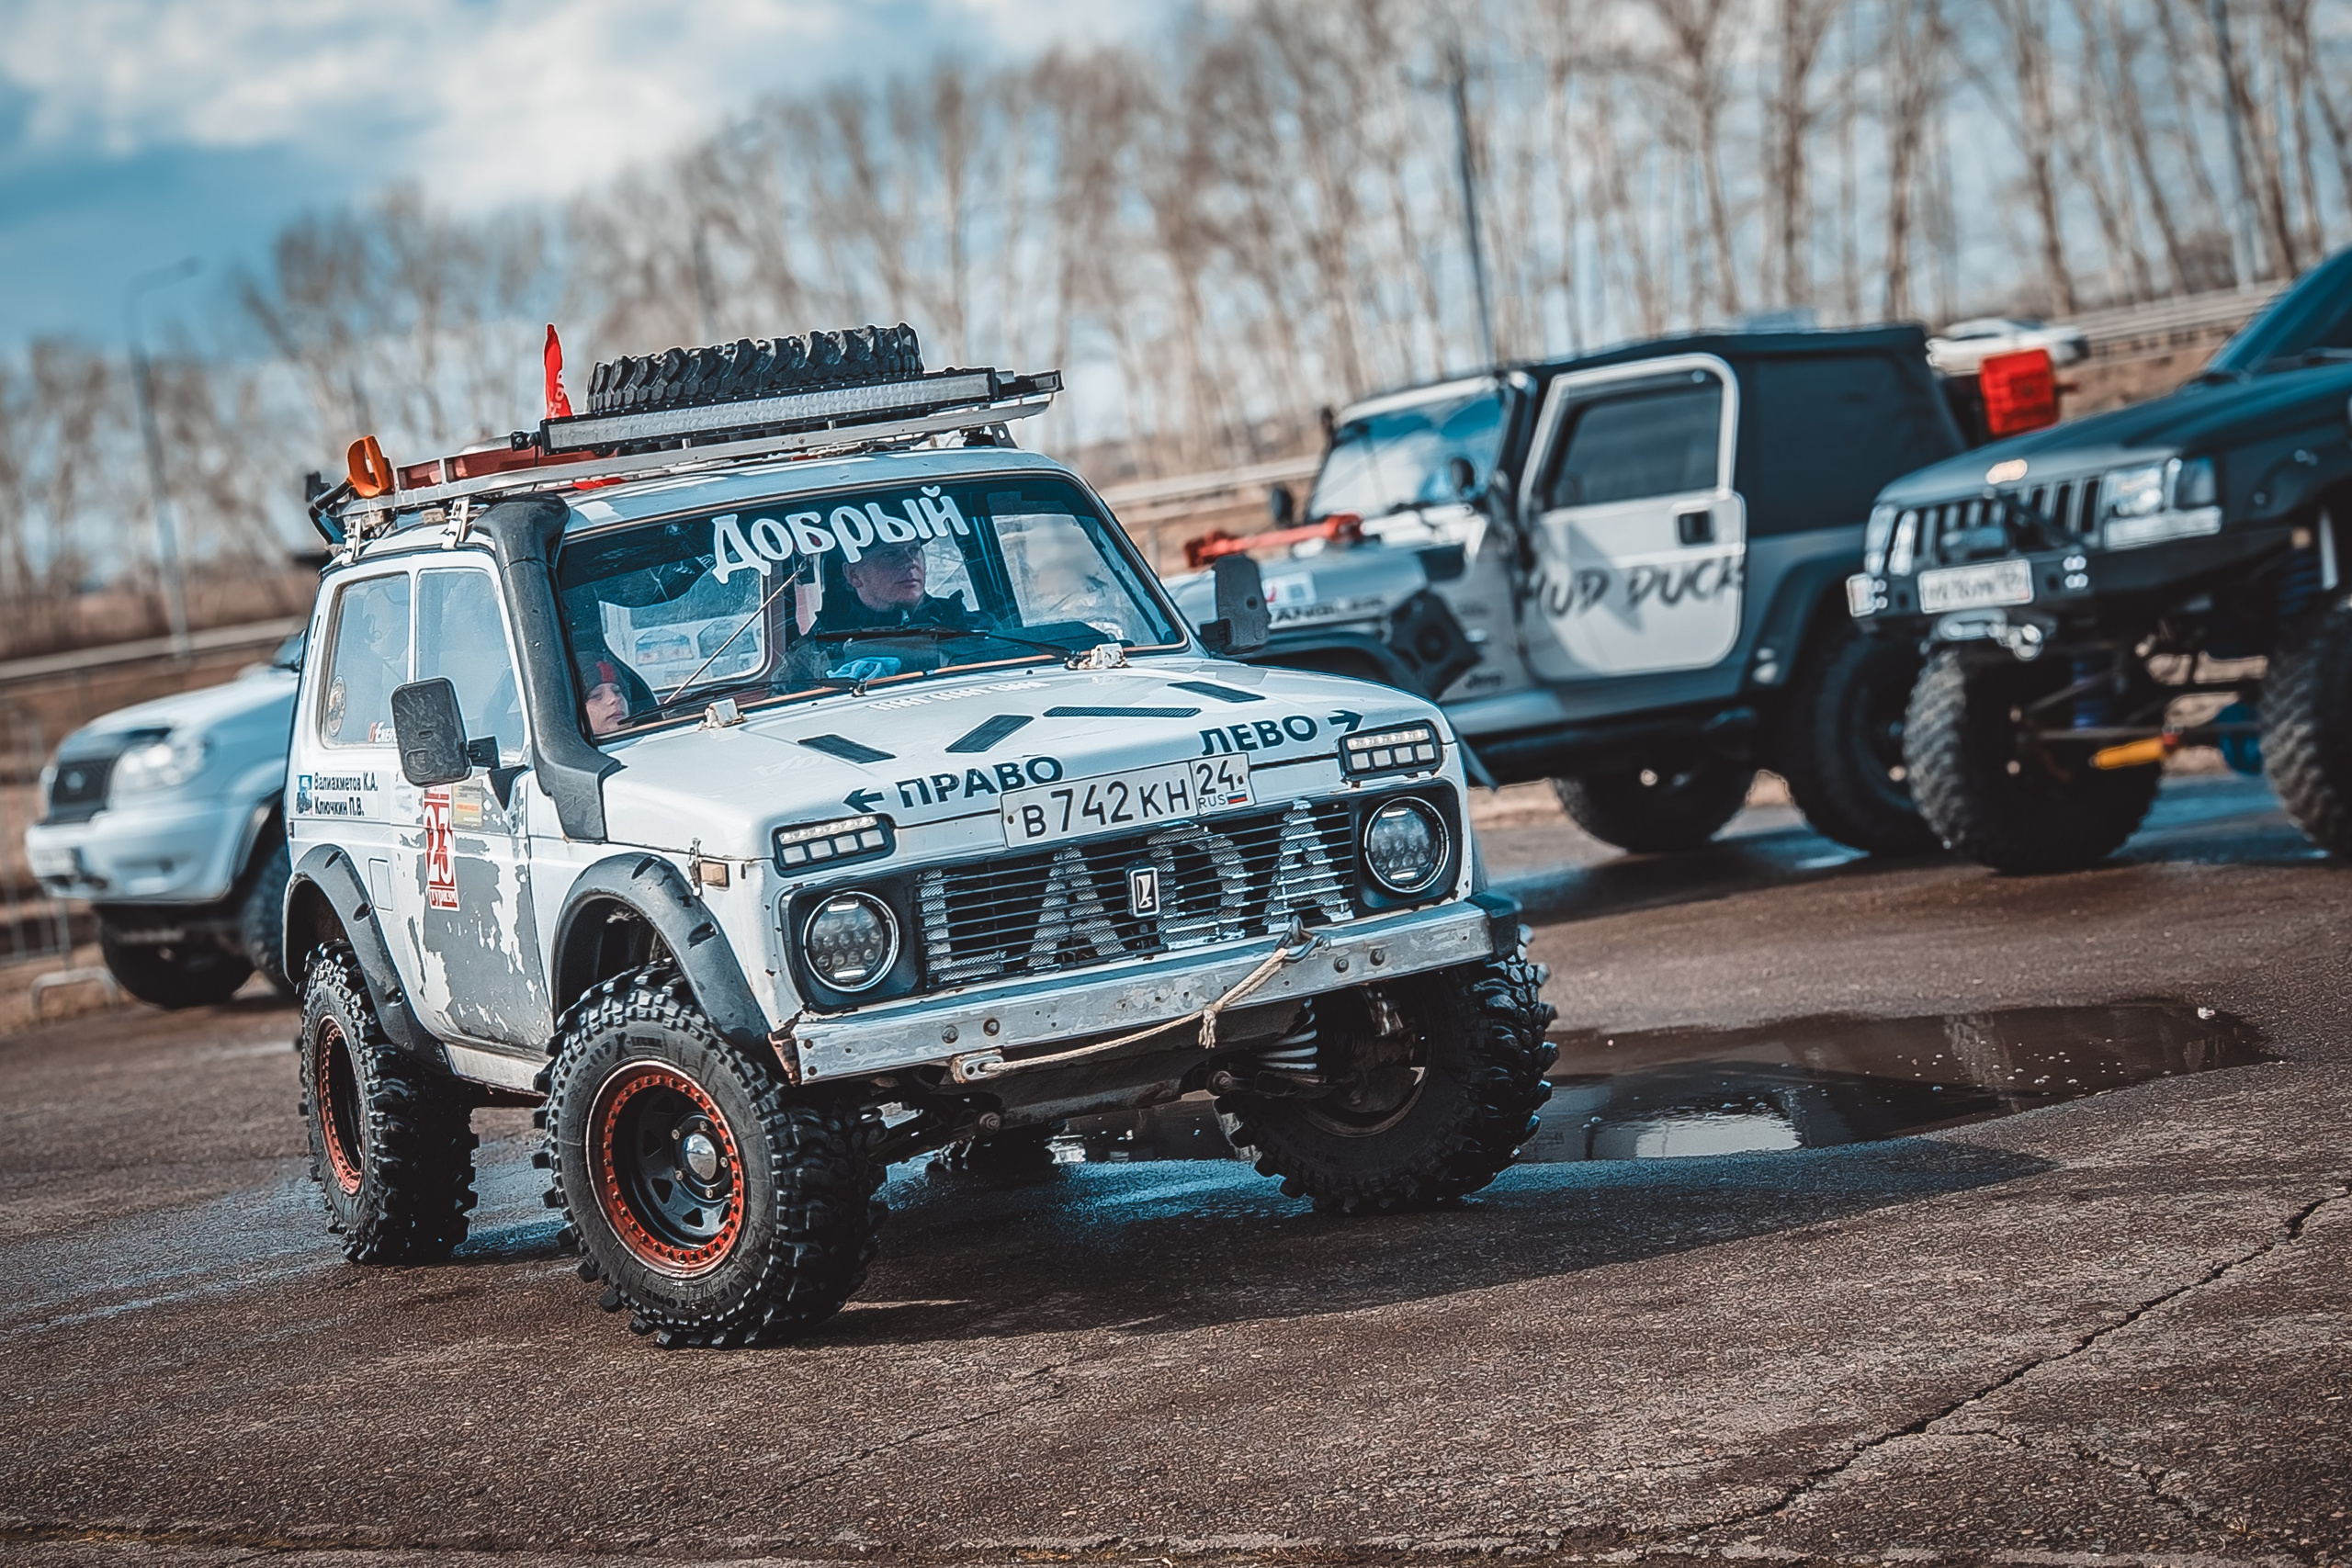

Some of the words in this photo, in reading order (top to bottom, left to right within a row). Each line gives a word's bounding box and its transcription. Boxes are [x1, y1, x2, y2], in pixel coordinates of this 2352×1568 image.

[1199, 715, 1318, 756] ЛЕВО
[314, 772, 361, 791] Валиахметов
[895, 756, 1063, 809] ПРАВО
[1196, 760, 1235, 795] 24
[314, 796, 348, 816] Ключкин
[349, 796, 365, 817] П.В.
[1198, 795, 1227, 809] RUS
